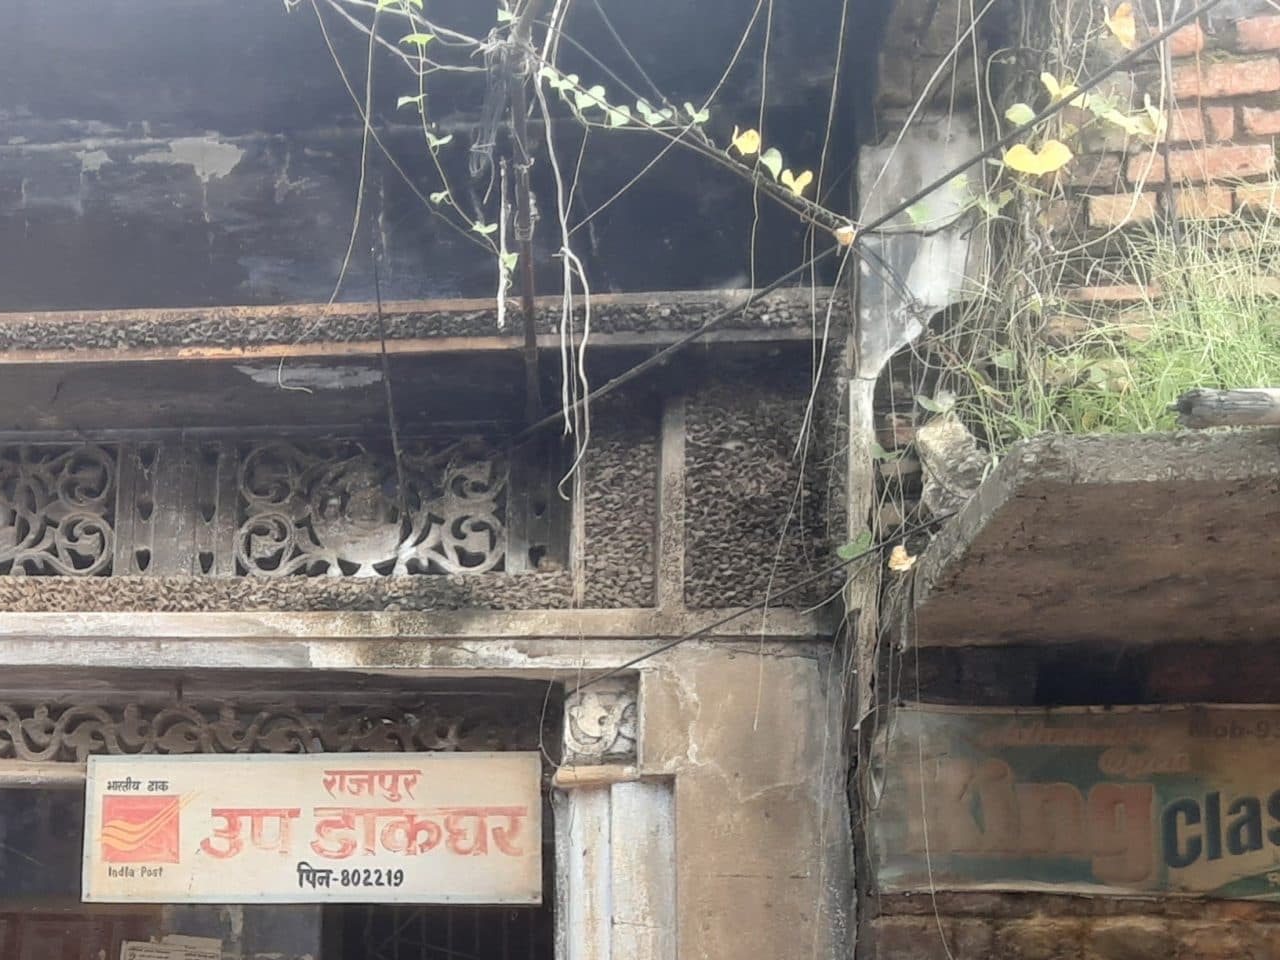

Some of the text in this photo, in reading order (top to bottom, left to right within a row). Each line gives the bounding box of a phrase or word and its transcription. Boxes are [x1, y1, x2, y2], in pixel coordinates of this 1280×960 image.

[107, 776, 141, 792] भारतीय
[322, 769, 421, 802] राजपुर
[200, 806, 529, 860] उप डाकघर
[108, 866, 163, 878] India Post
[297, 862, 405, 889] पिन-802219
